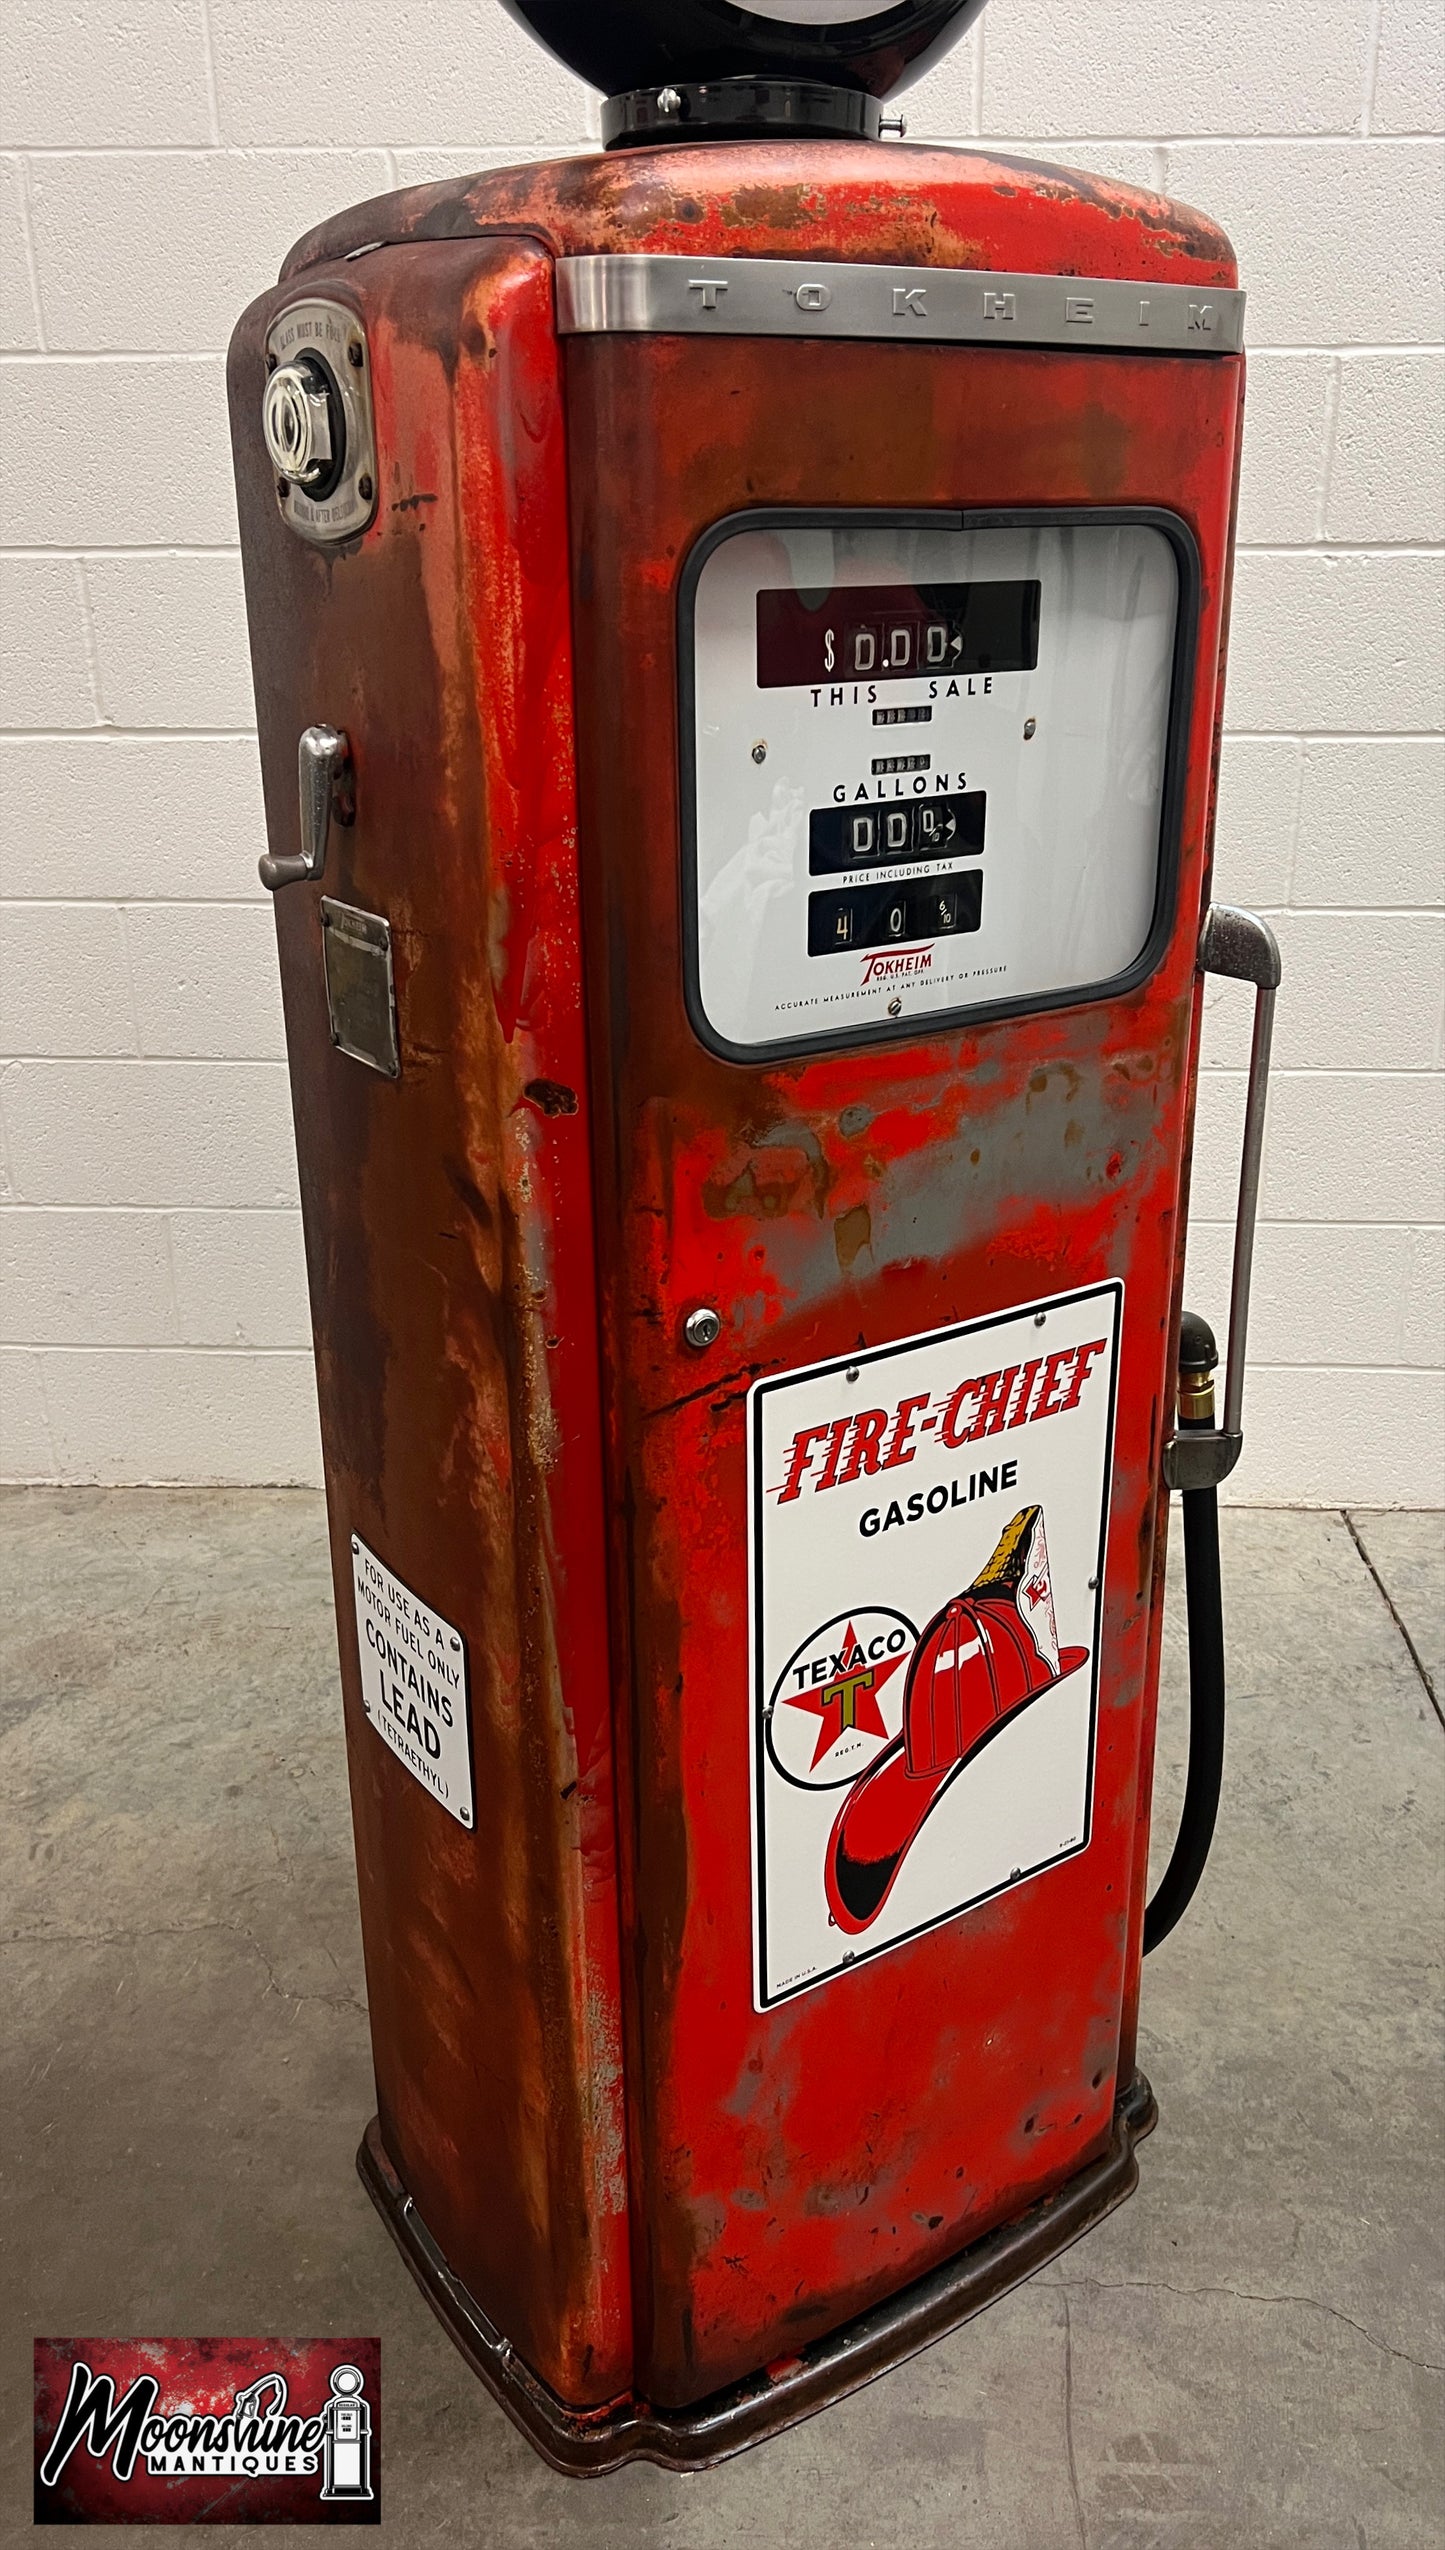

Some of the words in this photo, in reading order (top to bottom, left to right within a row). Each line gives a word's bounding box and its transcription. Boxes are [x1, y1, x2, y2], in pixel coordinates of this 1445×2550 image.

[688, 278, 1213, 331] TOKHEIM
[810, 684, 878, 707] THIS
[928, 676, 994, 700] SALE
[832, 772, 968, 803] GALLONS
[842, 872, 870, 884] PRICE
[876, 864, 930, 880] INCLUDING
[936, 861, 953, 872] TAX
[774, 997, 818, 1011] ACCURATE
[823, 987, 882, 1002] MEASUREMENT
[886, 984, 896, 992] AT
[900, 981, 915, 990] ANY
[920, 975, 954, 987] DELIVERY
[958, 972, 969, 980] OR
[972, 965, 1007, 977] PRESSURE
[859, 942, 936, 987] TOKHEIM
[770, 1338, 1108, 1505] FIRE-CHIEF
[859, 1460, 1018, 1537] GASOLINE
[357, 1575, 391, 1627] MOTOR
[395, 1617, 424, 1660] FUEL
[428, 1649, 460, 1690] ONLY
[365, 1558, 384, 1593] FOR
[388, 1583, 411, 1619] USE
[414, 1609, 430, 1637] AS
[436, 1628, 445, 1650] A
[366, 1618, 454, 1728] CONTAINS
[792, 1628, 906, 1690] TEXACO
[379, 1669, 441, 1760] LEAD
[377, 1708, 449, 1800] (TETRAETHYL)
